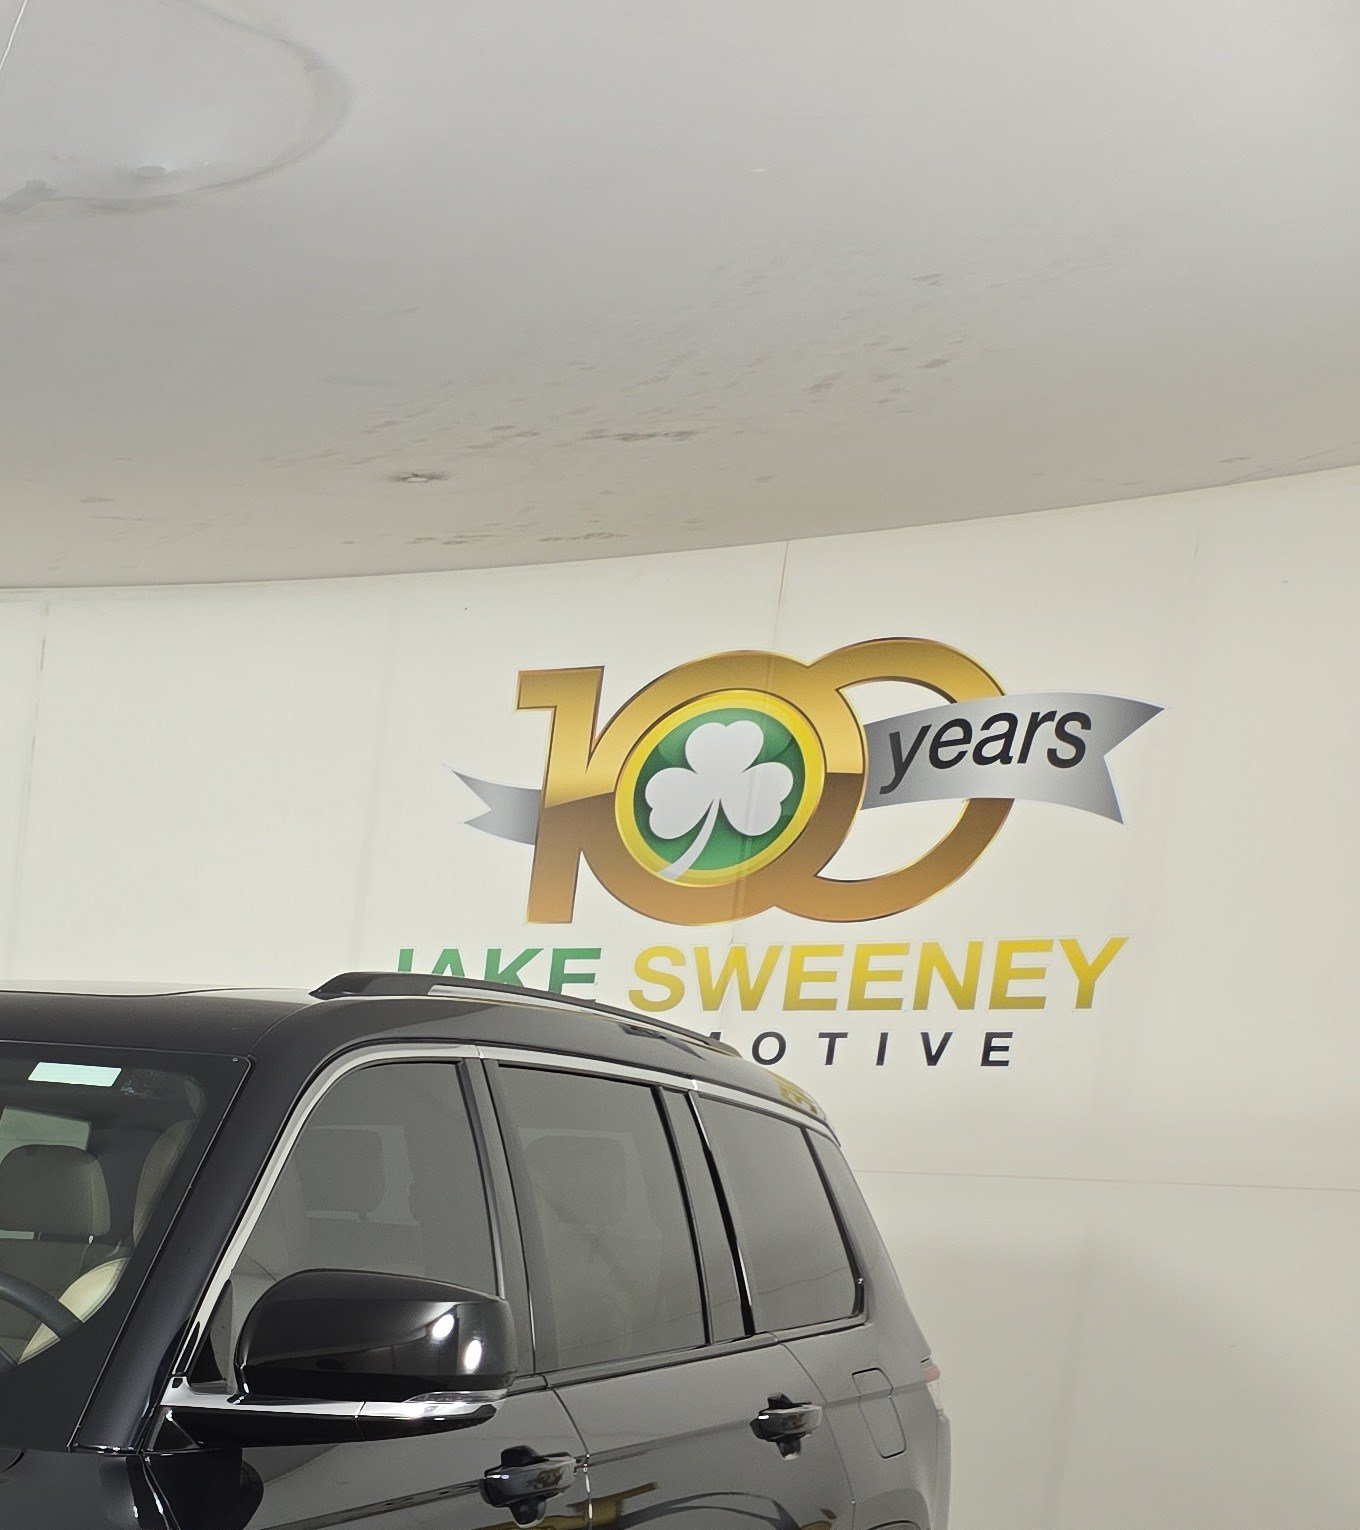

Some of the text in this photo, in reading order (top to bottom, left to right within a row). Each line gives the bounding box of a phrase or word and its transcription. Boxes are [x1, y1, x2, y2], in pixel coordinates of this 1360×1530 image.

[880, 706, 1092, 795] years
[629, 937, 1128, 1012] SWEENEY
[708, 1030, 1014, 1067] OTIVE
